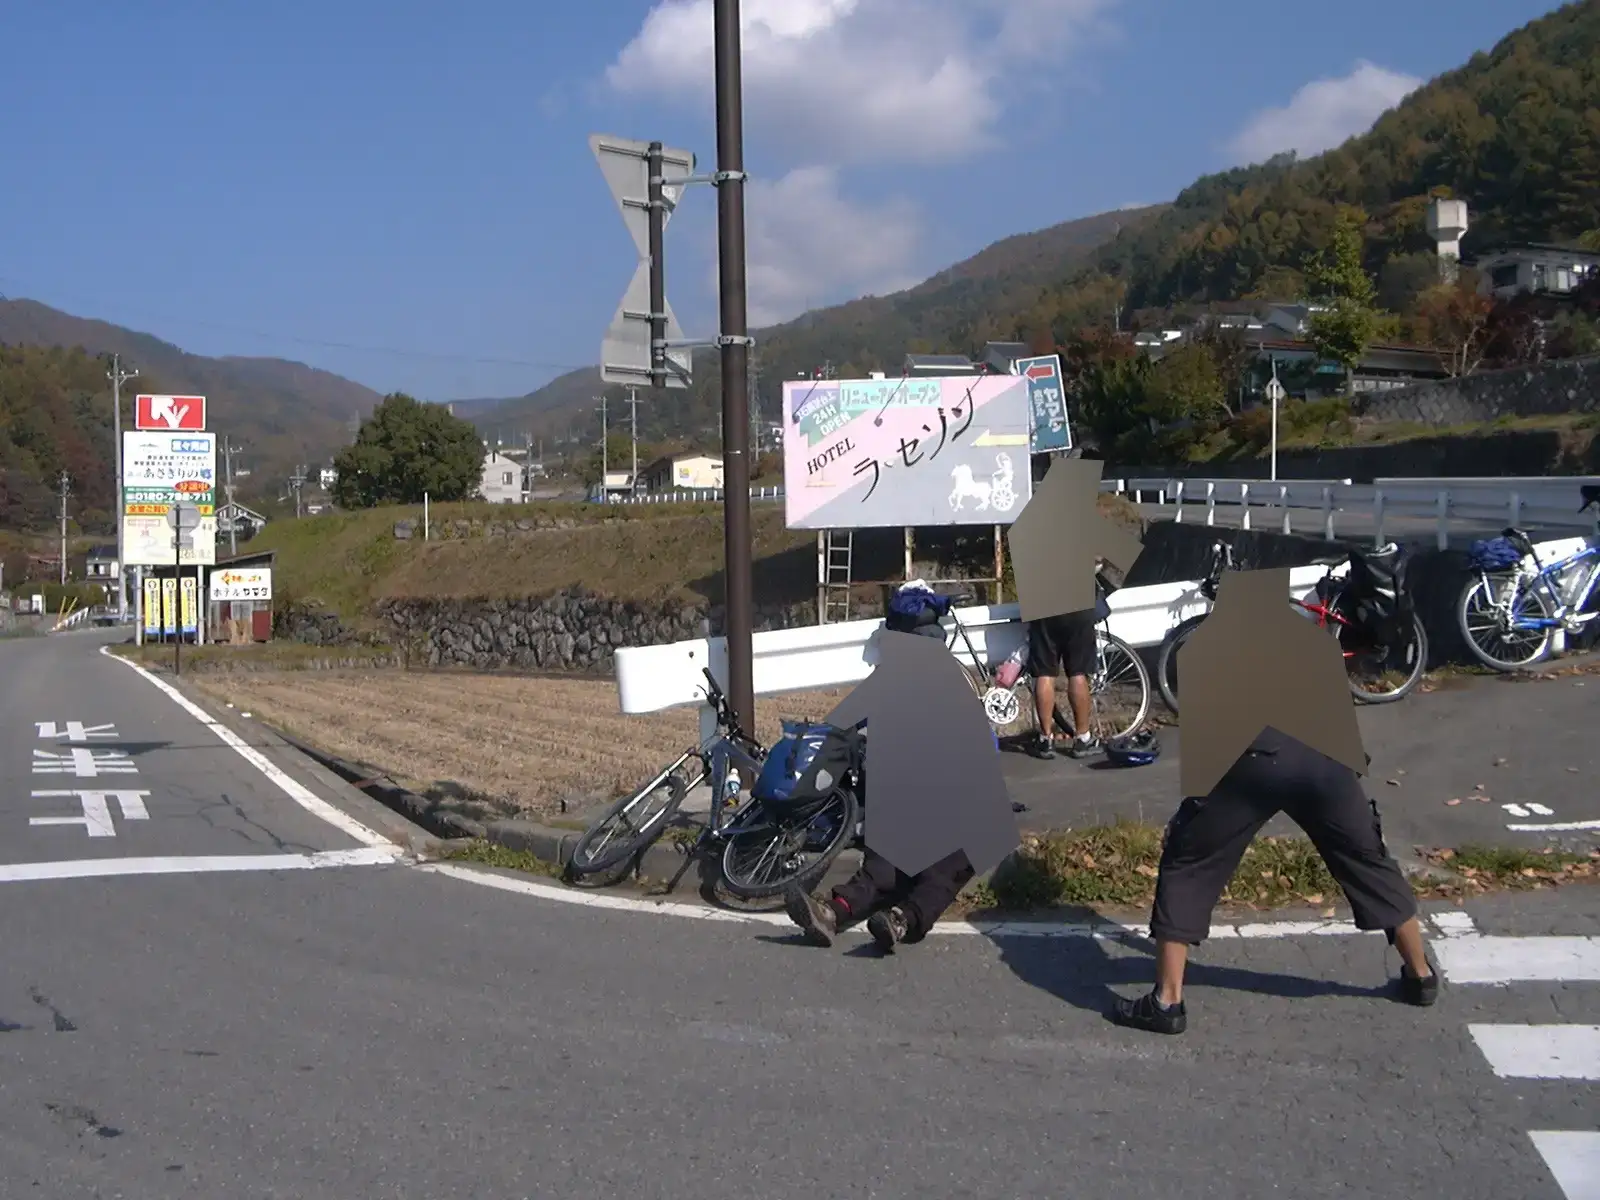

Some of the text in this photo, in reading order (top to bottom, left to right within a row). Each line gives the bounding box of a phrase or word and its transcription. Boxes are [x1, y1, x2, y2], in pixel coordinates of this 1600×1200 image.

[812, 404, 837, 425] 24H
[820, 410, 852, 436] OPEN
[806, 437, 856, 475] HOTEL
[29, 721, 151, 837] 止まれ
